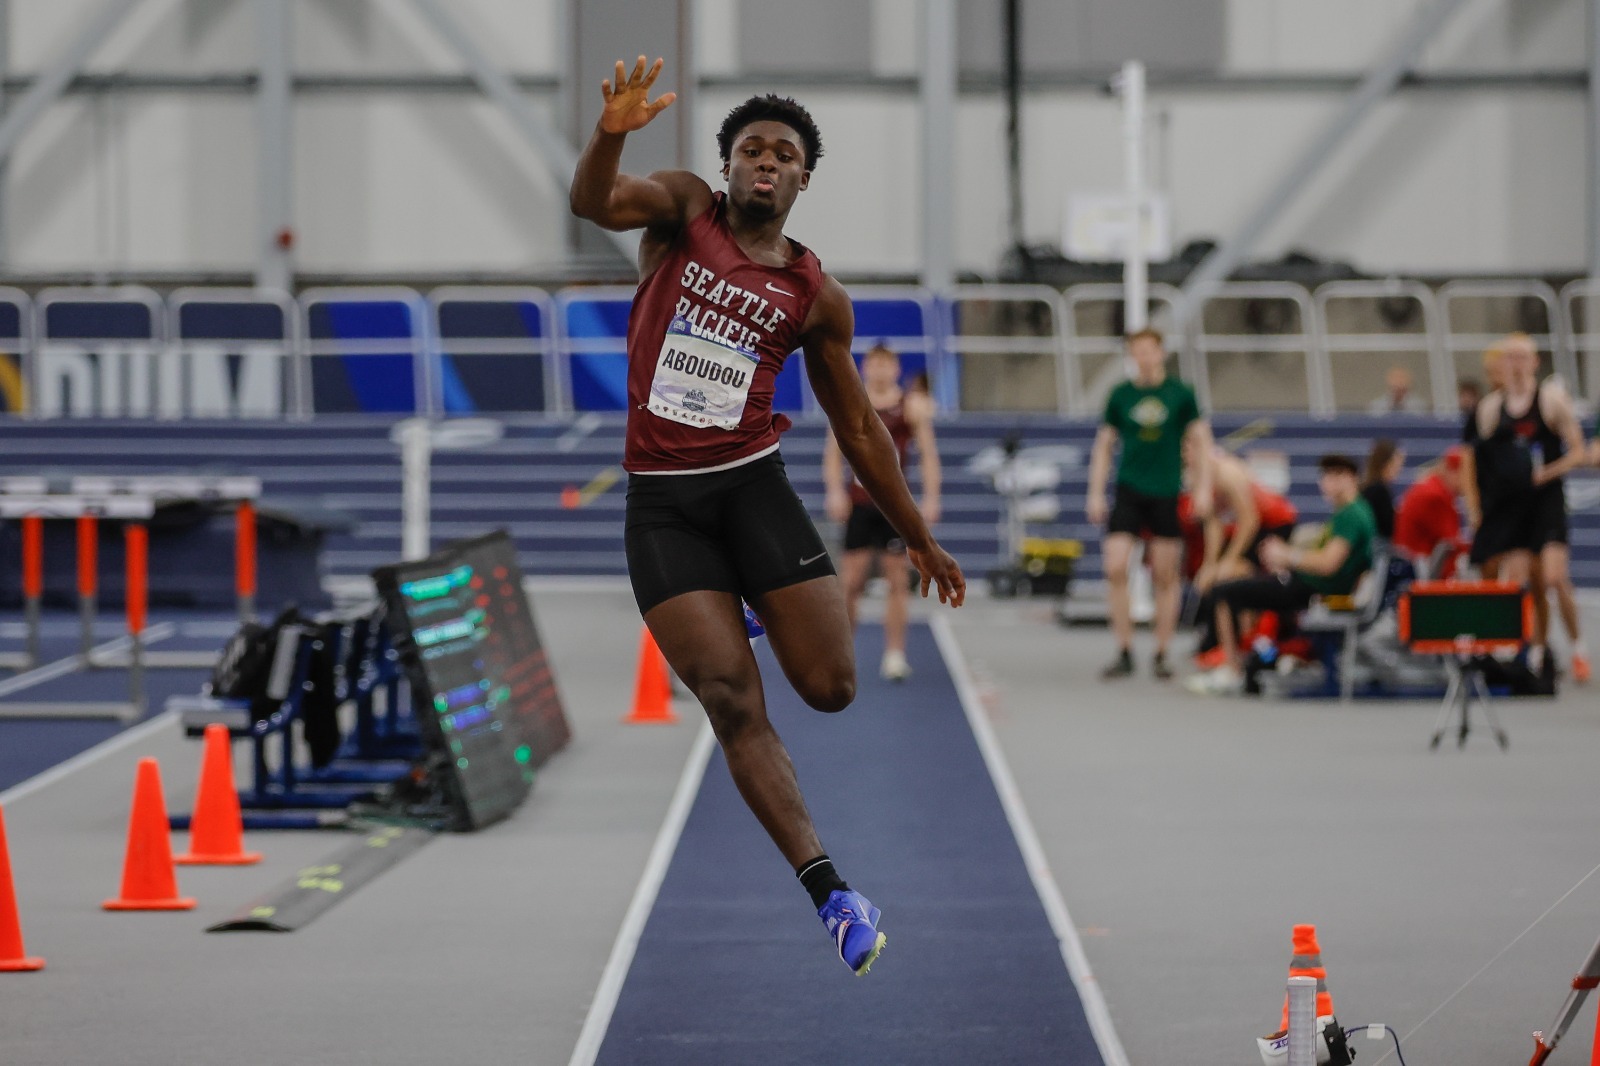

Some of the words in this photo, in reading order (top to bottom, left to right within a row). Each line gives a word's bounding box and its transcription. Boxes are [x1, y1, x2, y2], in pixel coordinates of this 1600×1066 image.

[675, 295, 762, 352] PACIFIC
[680, 260, 787, 334] SEATTLE
[661, 347, 747, 390] ABOUDOU
